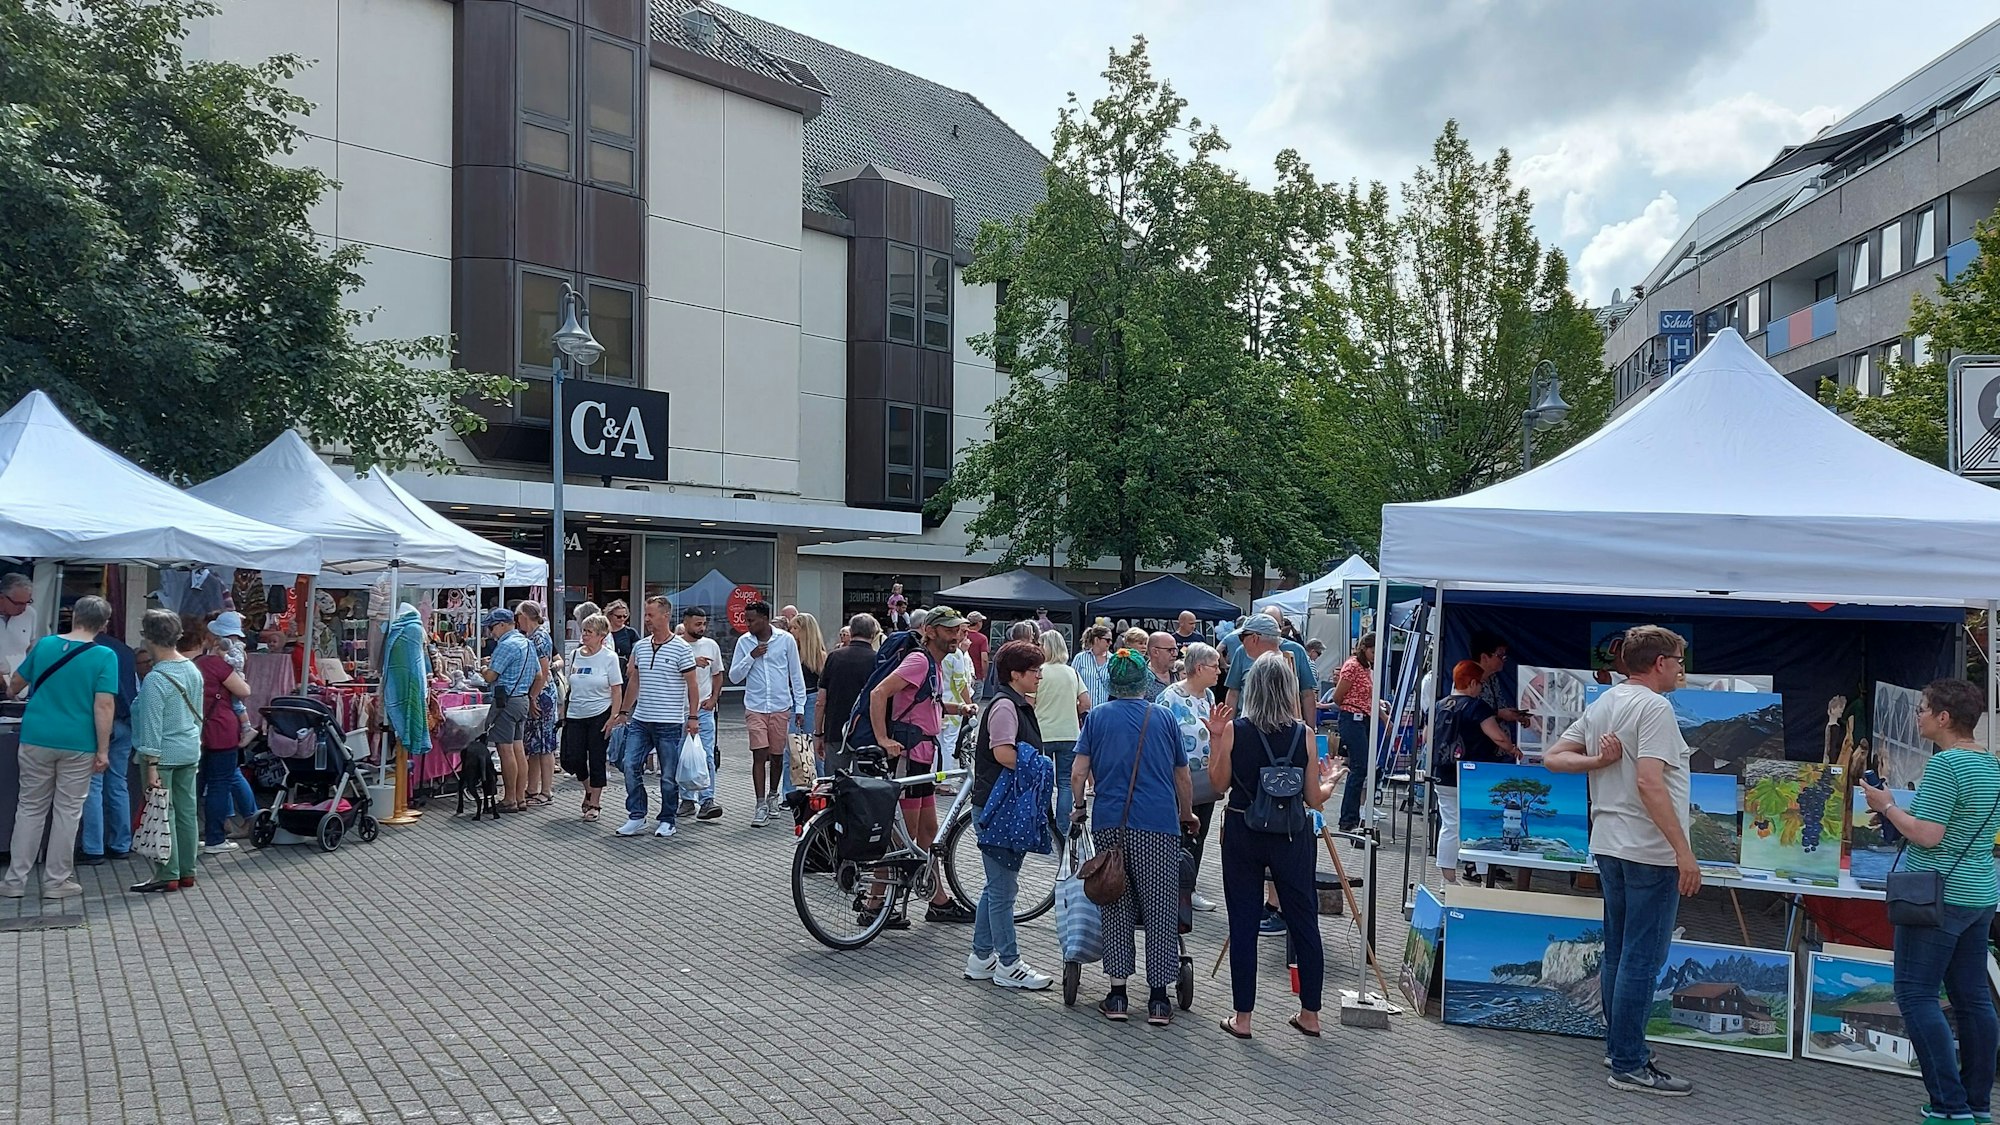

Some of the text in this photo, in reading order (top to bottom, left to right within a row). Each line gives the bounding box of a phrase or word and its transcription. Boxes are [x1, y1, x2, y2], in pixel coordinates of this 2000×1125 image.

[1662, 314, 1693, 329] Schuh
[570, 400, 654, 460] C&A
[564, 531, 583, 551] &A
[734, 588, 757, 601] Super
